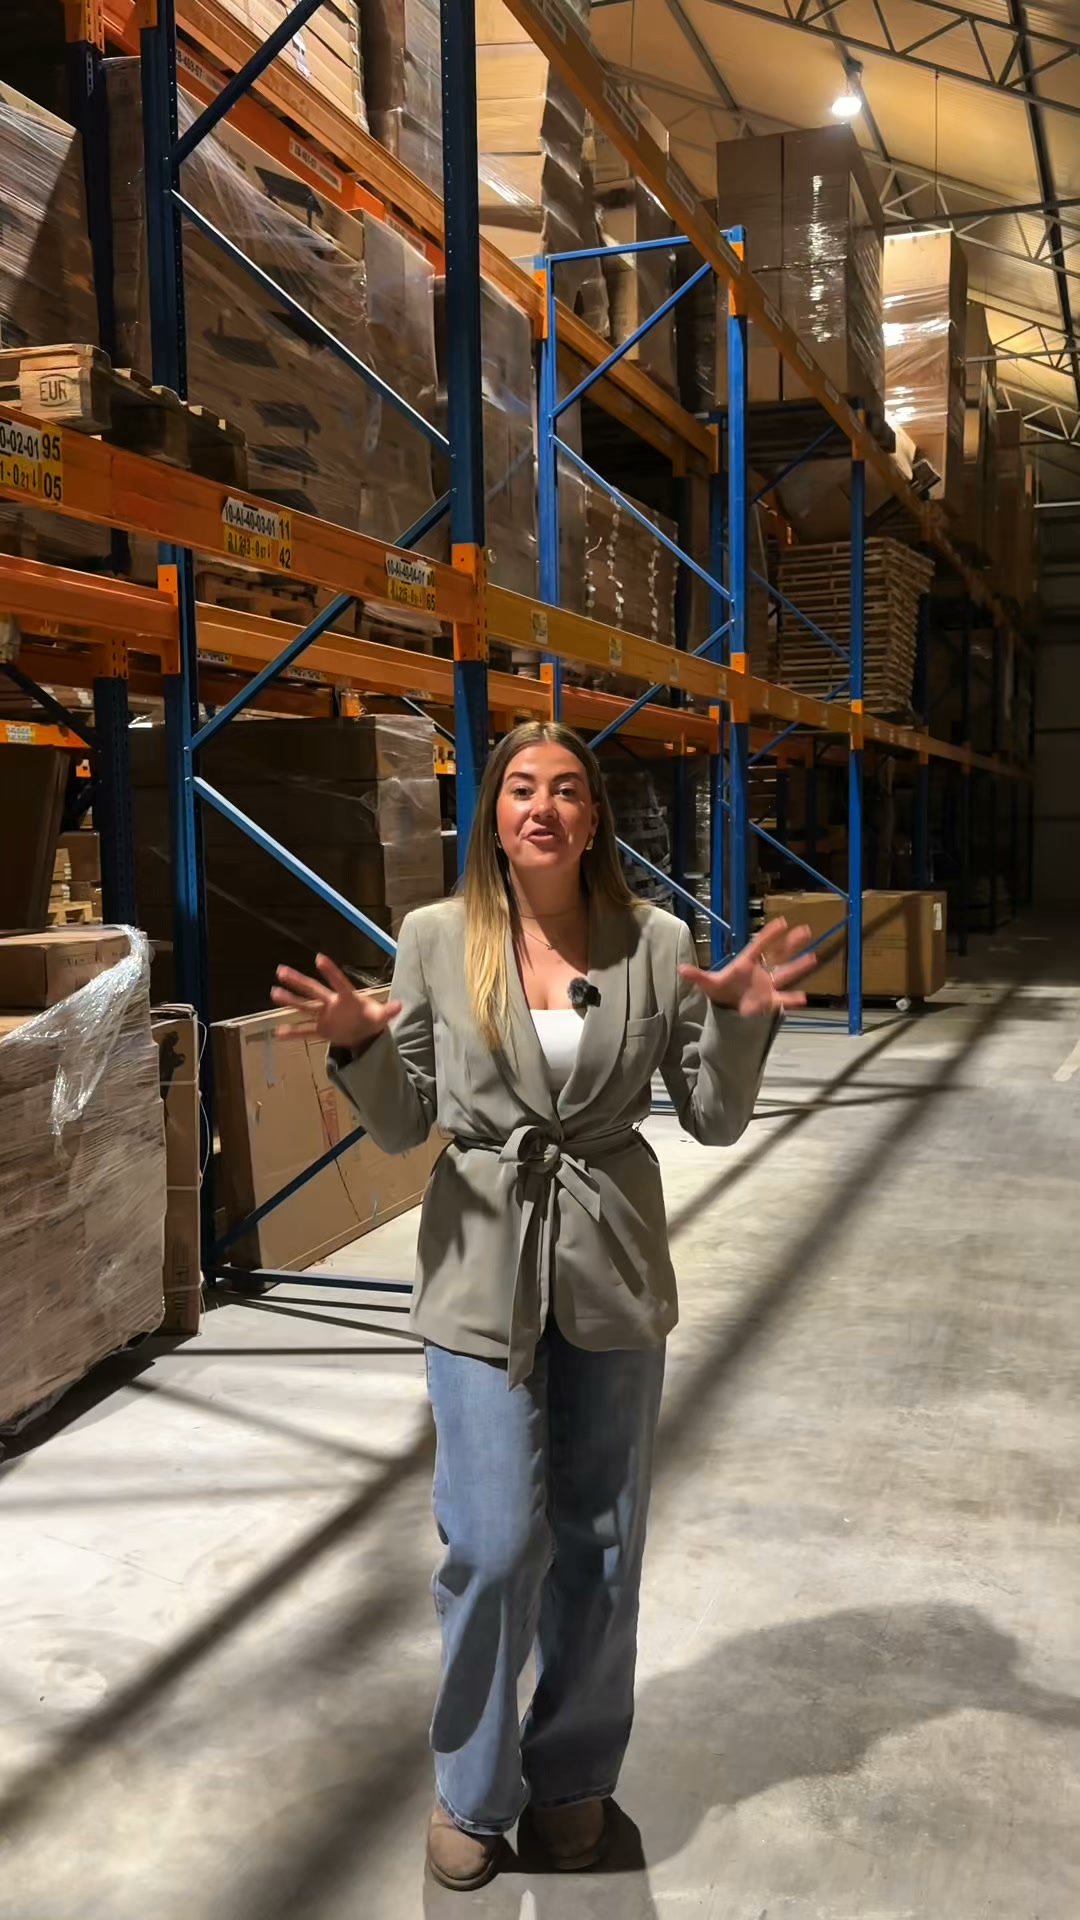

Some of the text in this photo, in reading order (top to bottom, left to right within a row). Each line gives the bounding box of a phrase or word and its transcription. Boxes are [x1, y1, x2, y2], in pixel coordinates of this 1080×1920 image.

[39, 379, 68, 402] EUR
[41, 433, 61, 462] 95
[43, 472, 62, 501] 05
[278, 518, 290, 541] 11
[279, 546, 291, 569] 42
